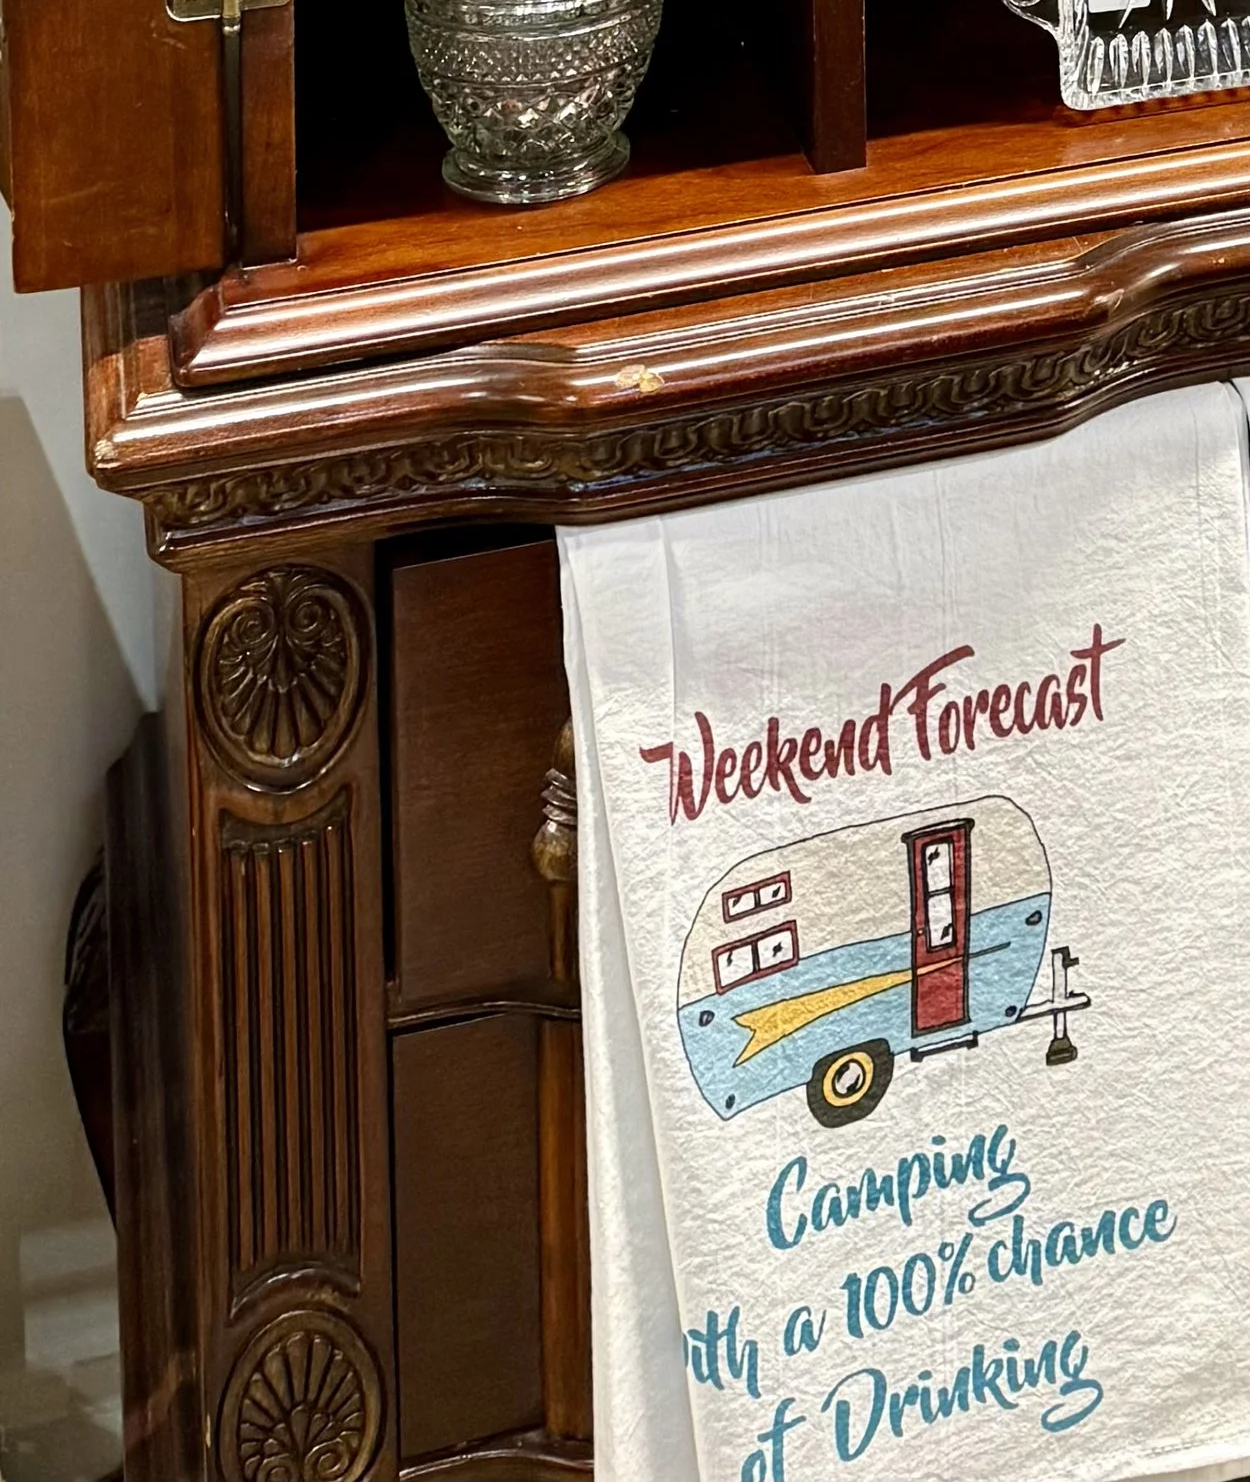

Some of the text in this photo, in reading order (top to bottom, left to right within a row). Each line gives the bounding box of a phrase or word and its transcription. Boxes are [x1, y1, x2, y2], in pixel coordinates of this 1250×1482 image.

[638, 624, 1125, 826] Weekend Forecast
[766, 1124, 1031, 1251] Camping
[683, 1198, 1178, 1399] ith a 100% chance
[822, 1330, 1104, 1464] Drinking
